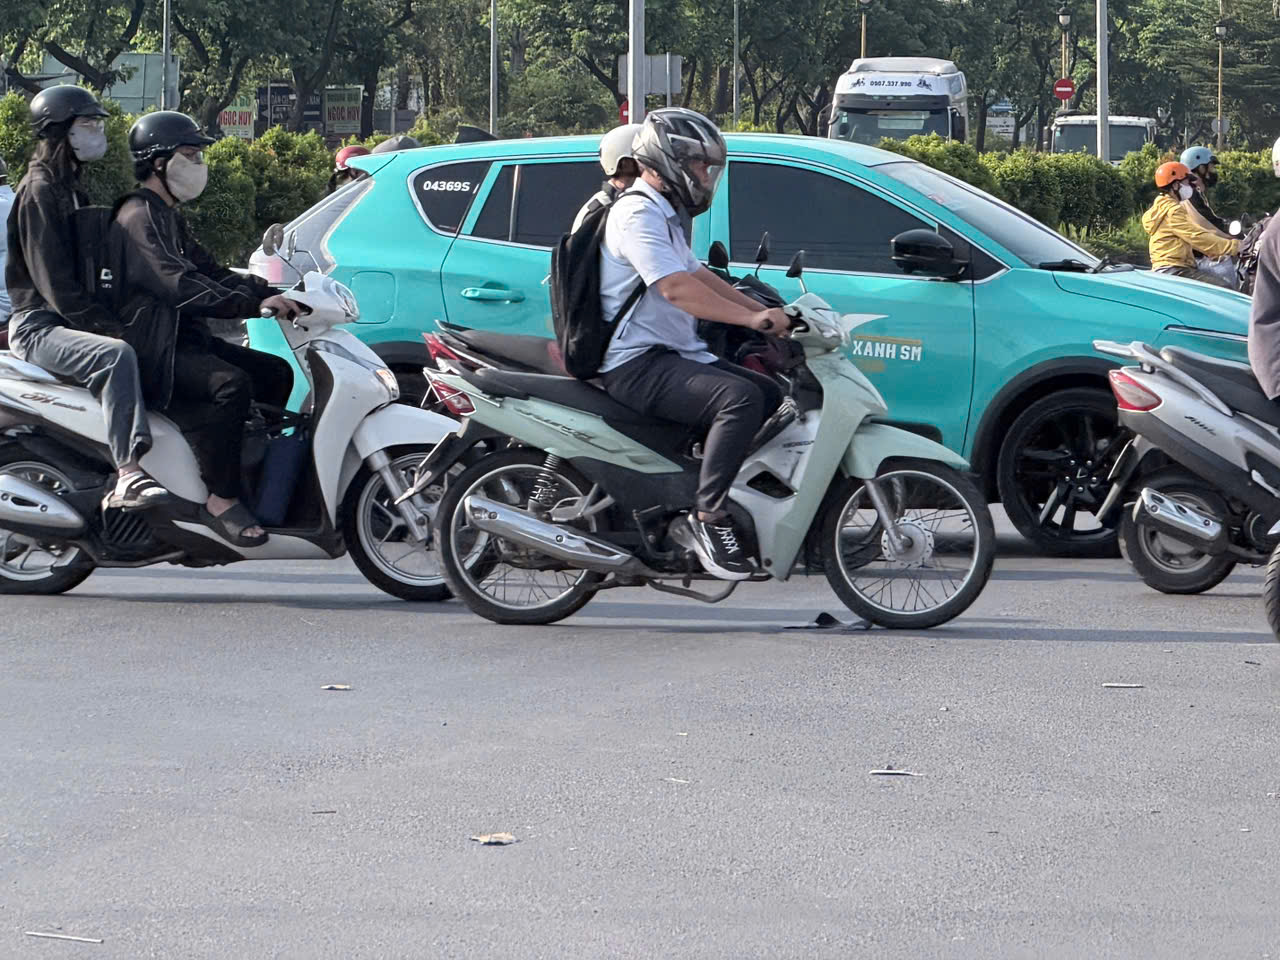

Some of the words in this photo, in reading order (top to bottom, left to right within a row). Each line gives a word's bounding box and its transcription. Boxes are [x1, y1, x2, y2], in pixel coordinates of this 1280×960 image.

[423, 180, 471, 192] 04369S
[852, 340, 897, 359] XANH
[900, 345, 923, 362] SM
